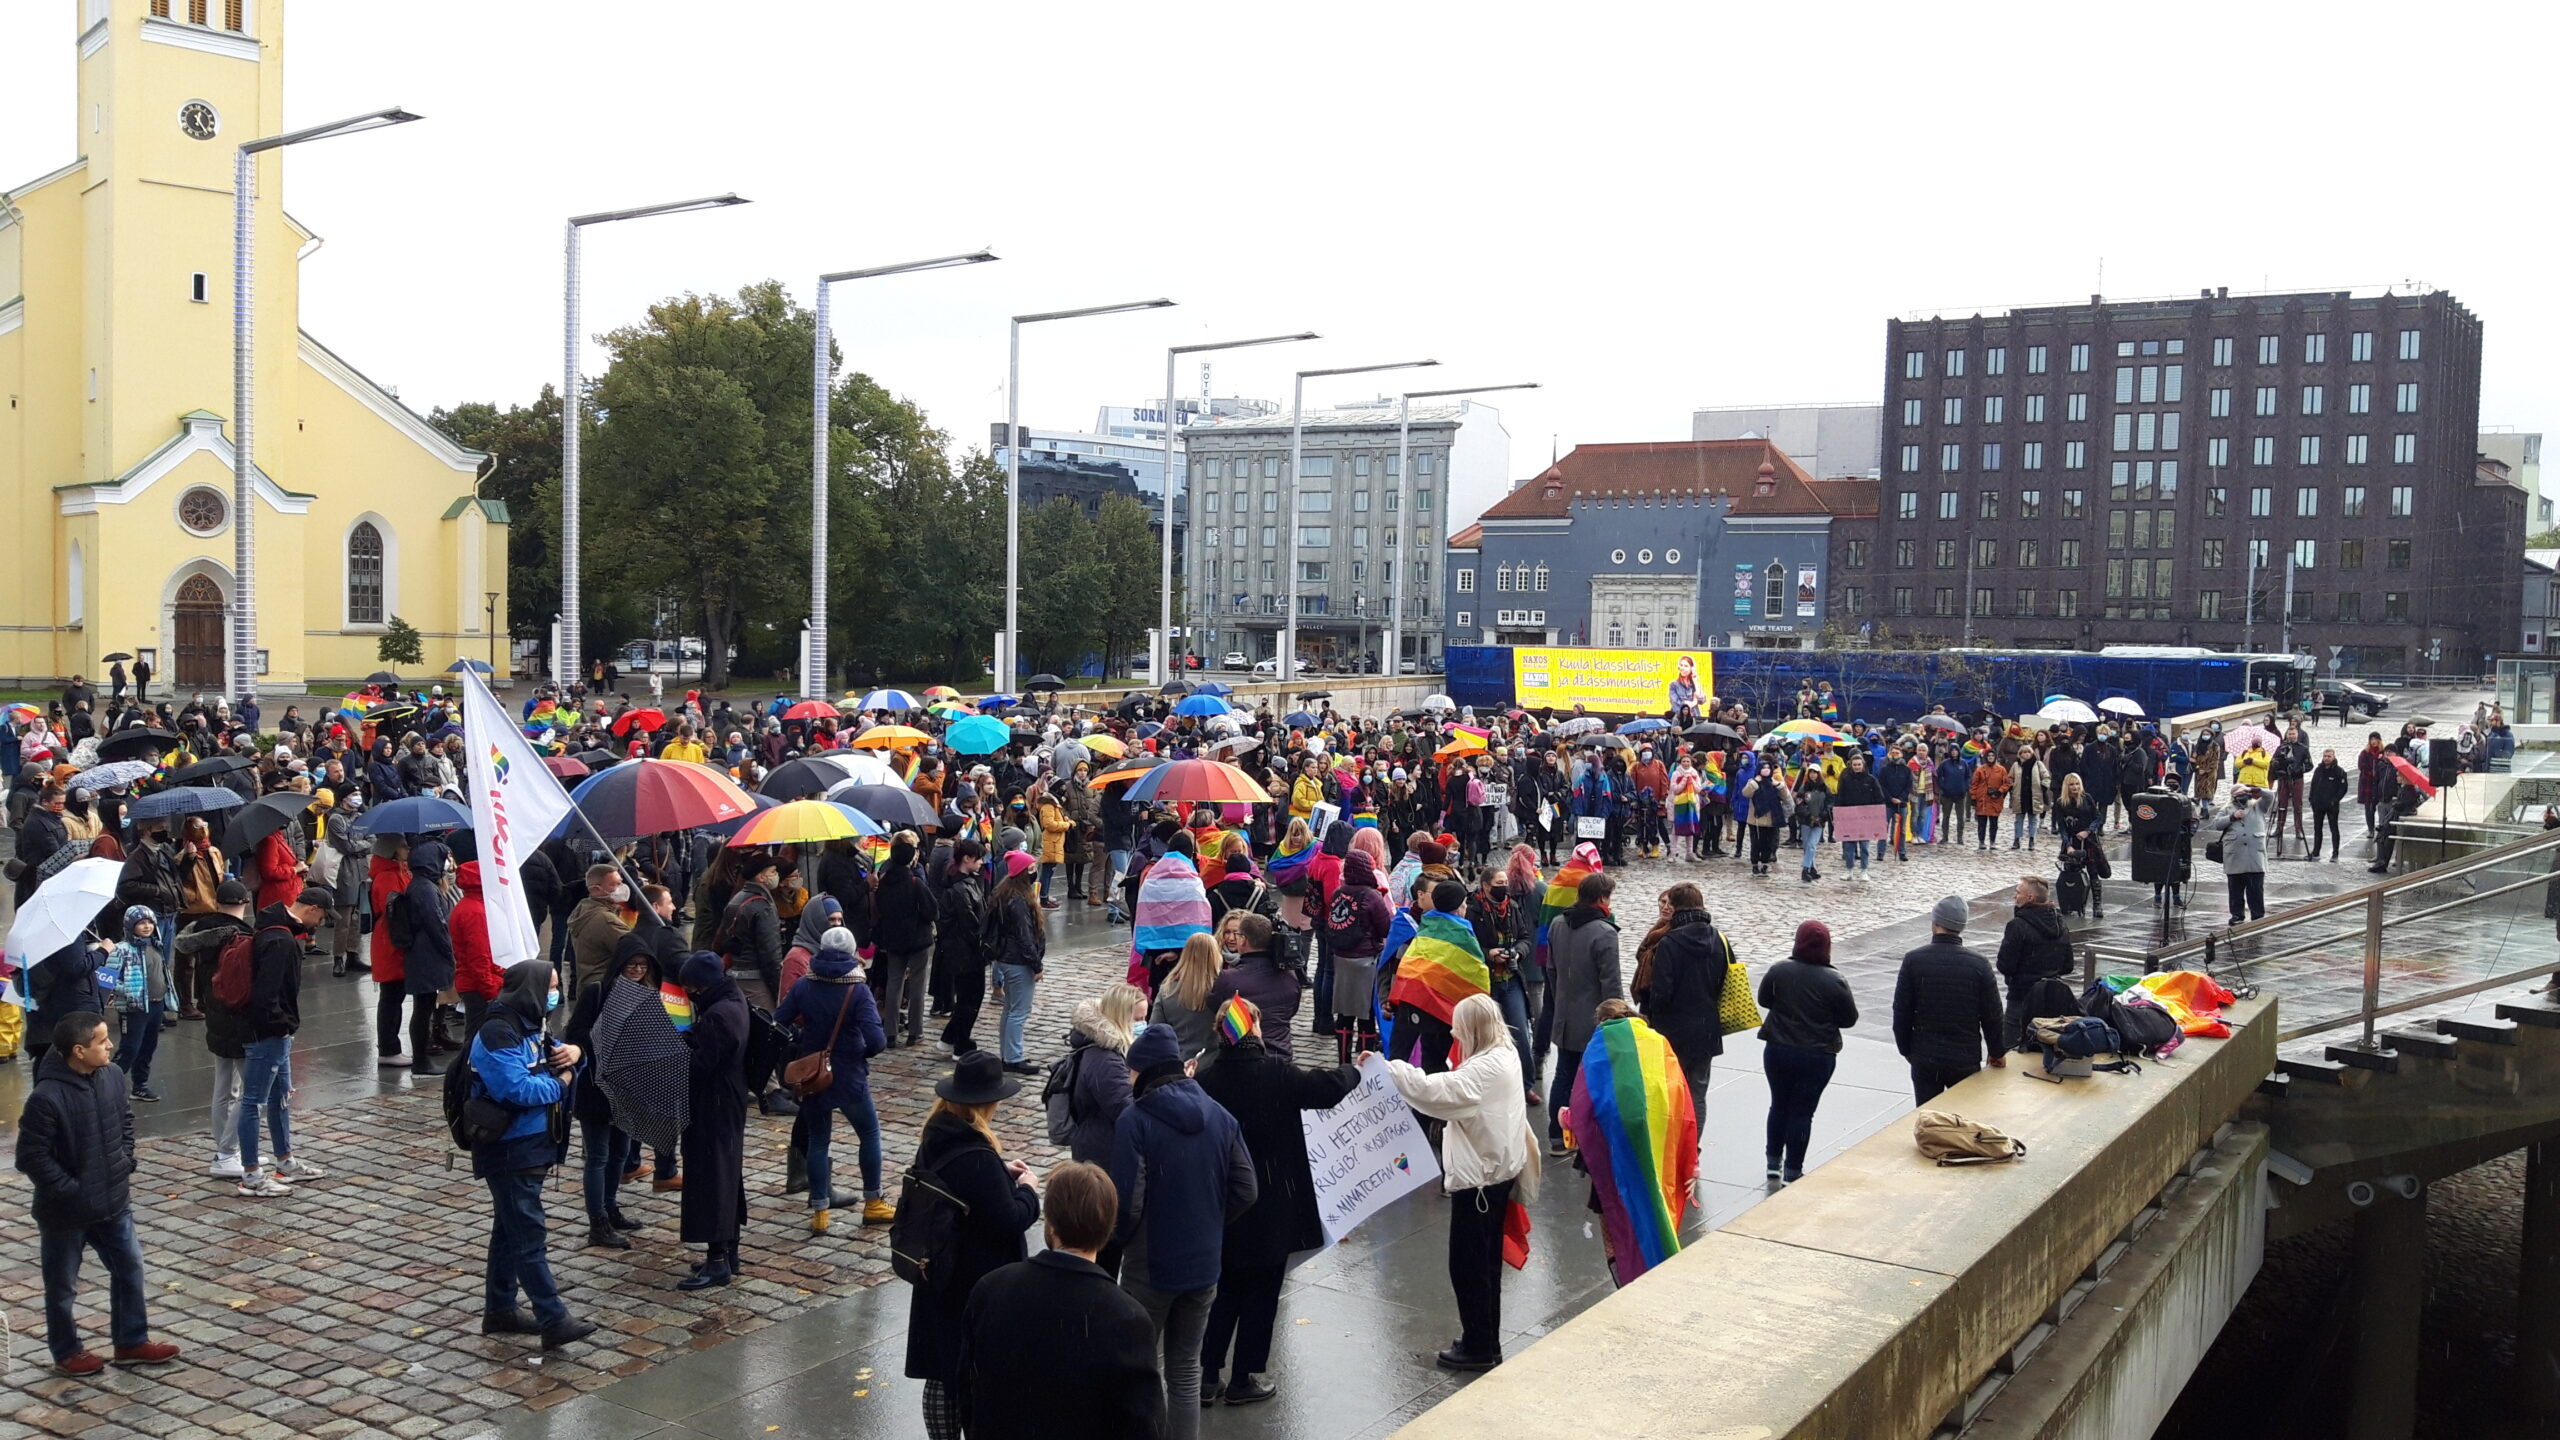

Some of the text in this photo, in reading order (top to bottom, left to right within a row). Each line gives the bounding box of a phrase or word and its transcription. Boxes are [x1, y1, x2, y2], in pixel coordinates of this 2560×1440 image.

[1133, 408, 1188, 425] SORAIEN
[1522, 655, 1548, 664] NAXOS
[1559, 657, 1661, 672] Kuula klassikalist
[1557, 673, 1662, 688] ja džässmuusikat
[1348, 1073, 1385, 1107] HELME
[1307, 1142, 1327, 1170] NU
